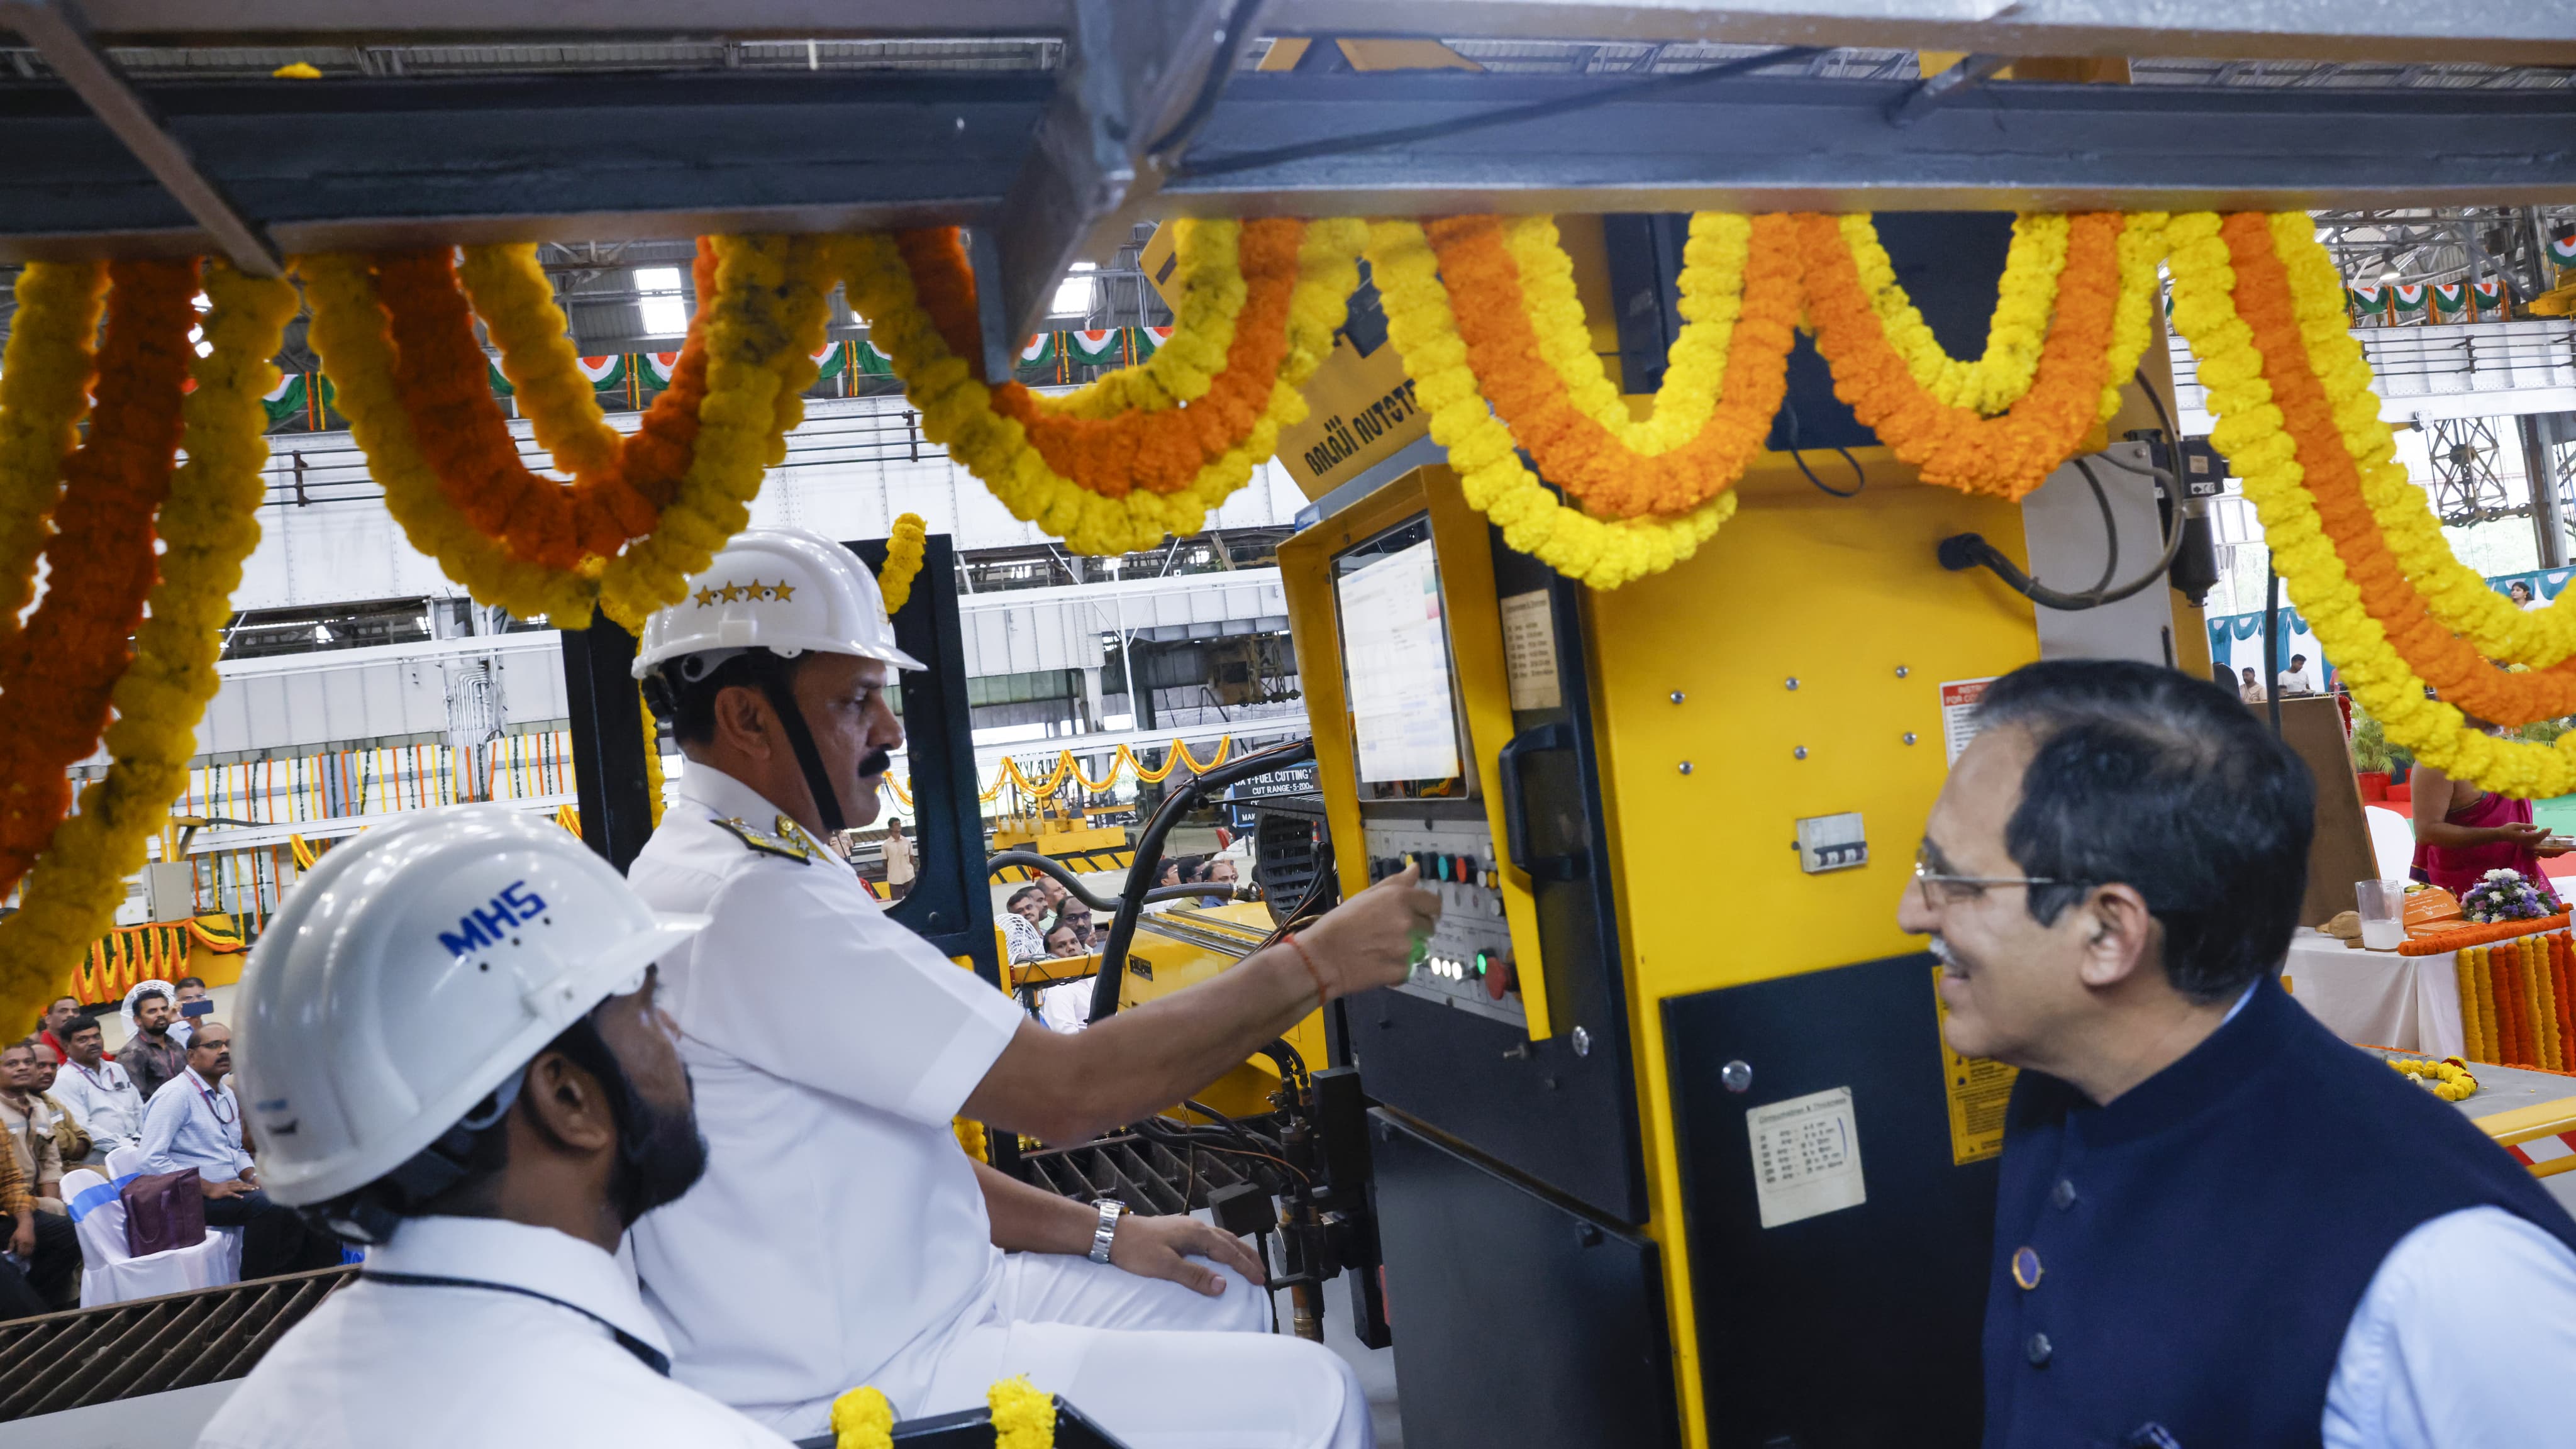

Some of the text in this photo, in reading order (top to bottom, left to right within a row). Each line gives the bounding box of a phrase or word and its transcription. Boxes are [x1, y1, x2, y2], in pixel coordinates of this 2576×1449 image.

[1275, 769, 1308, 782] CUTTING
[1252, 786, 1265, 794] CUT
[438, 880, 547, 959] MHS
